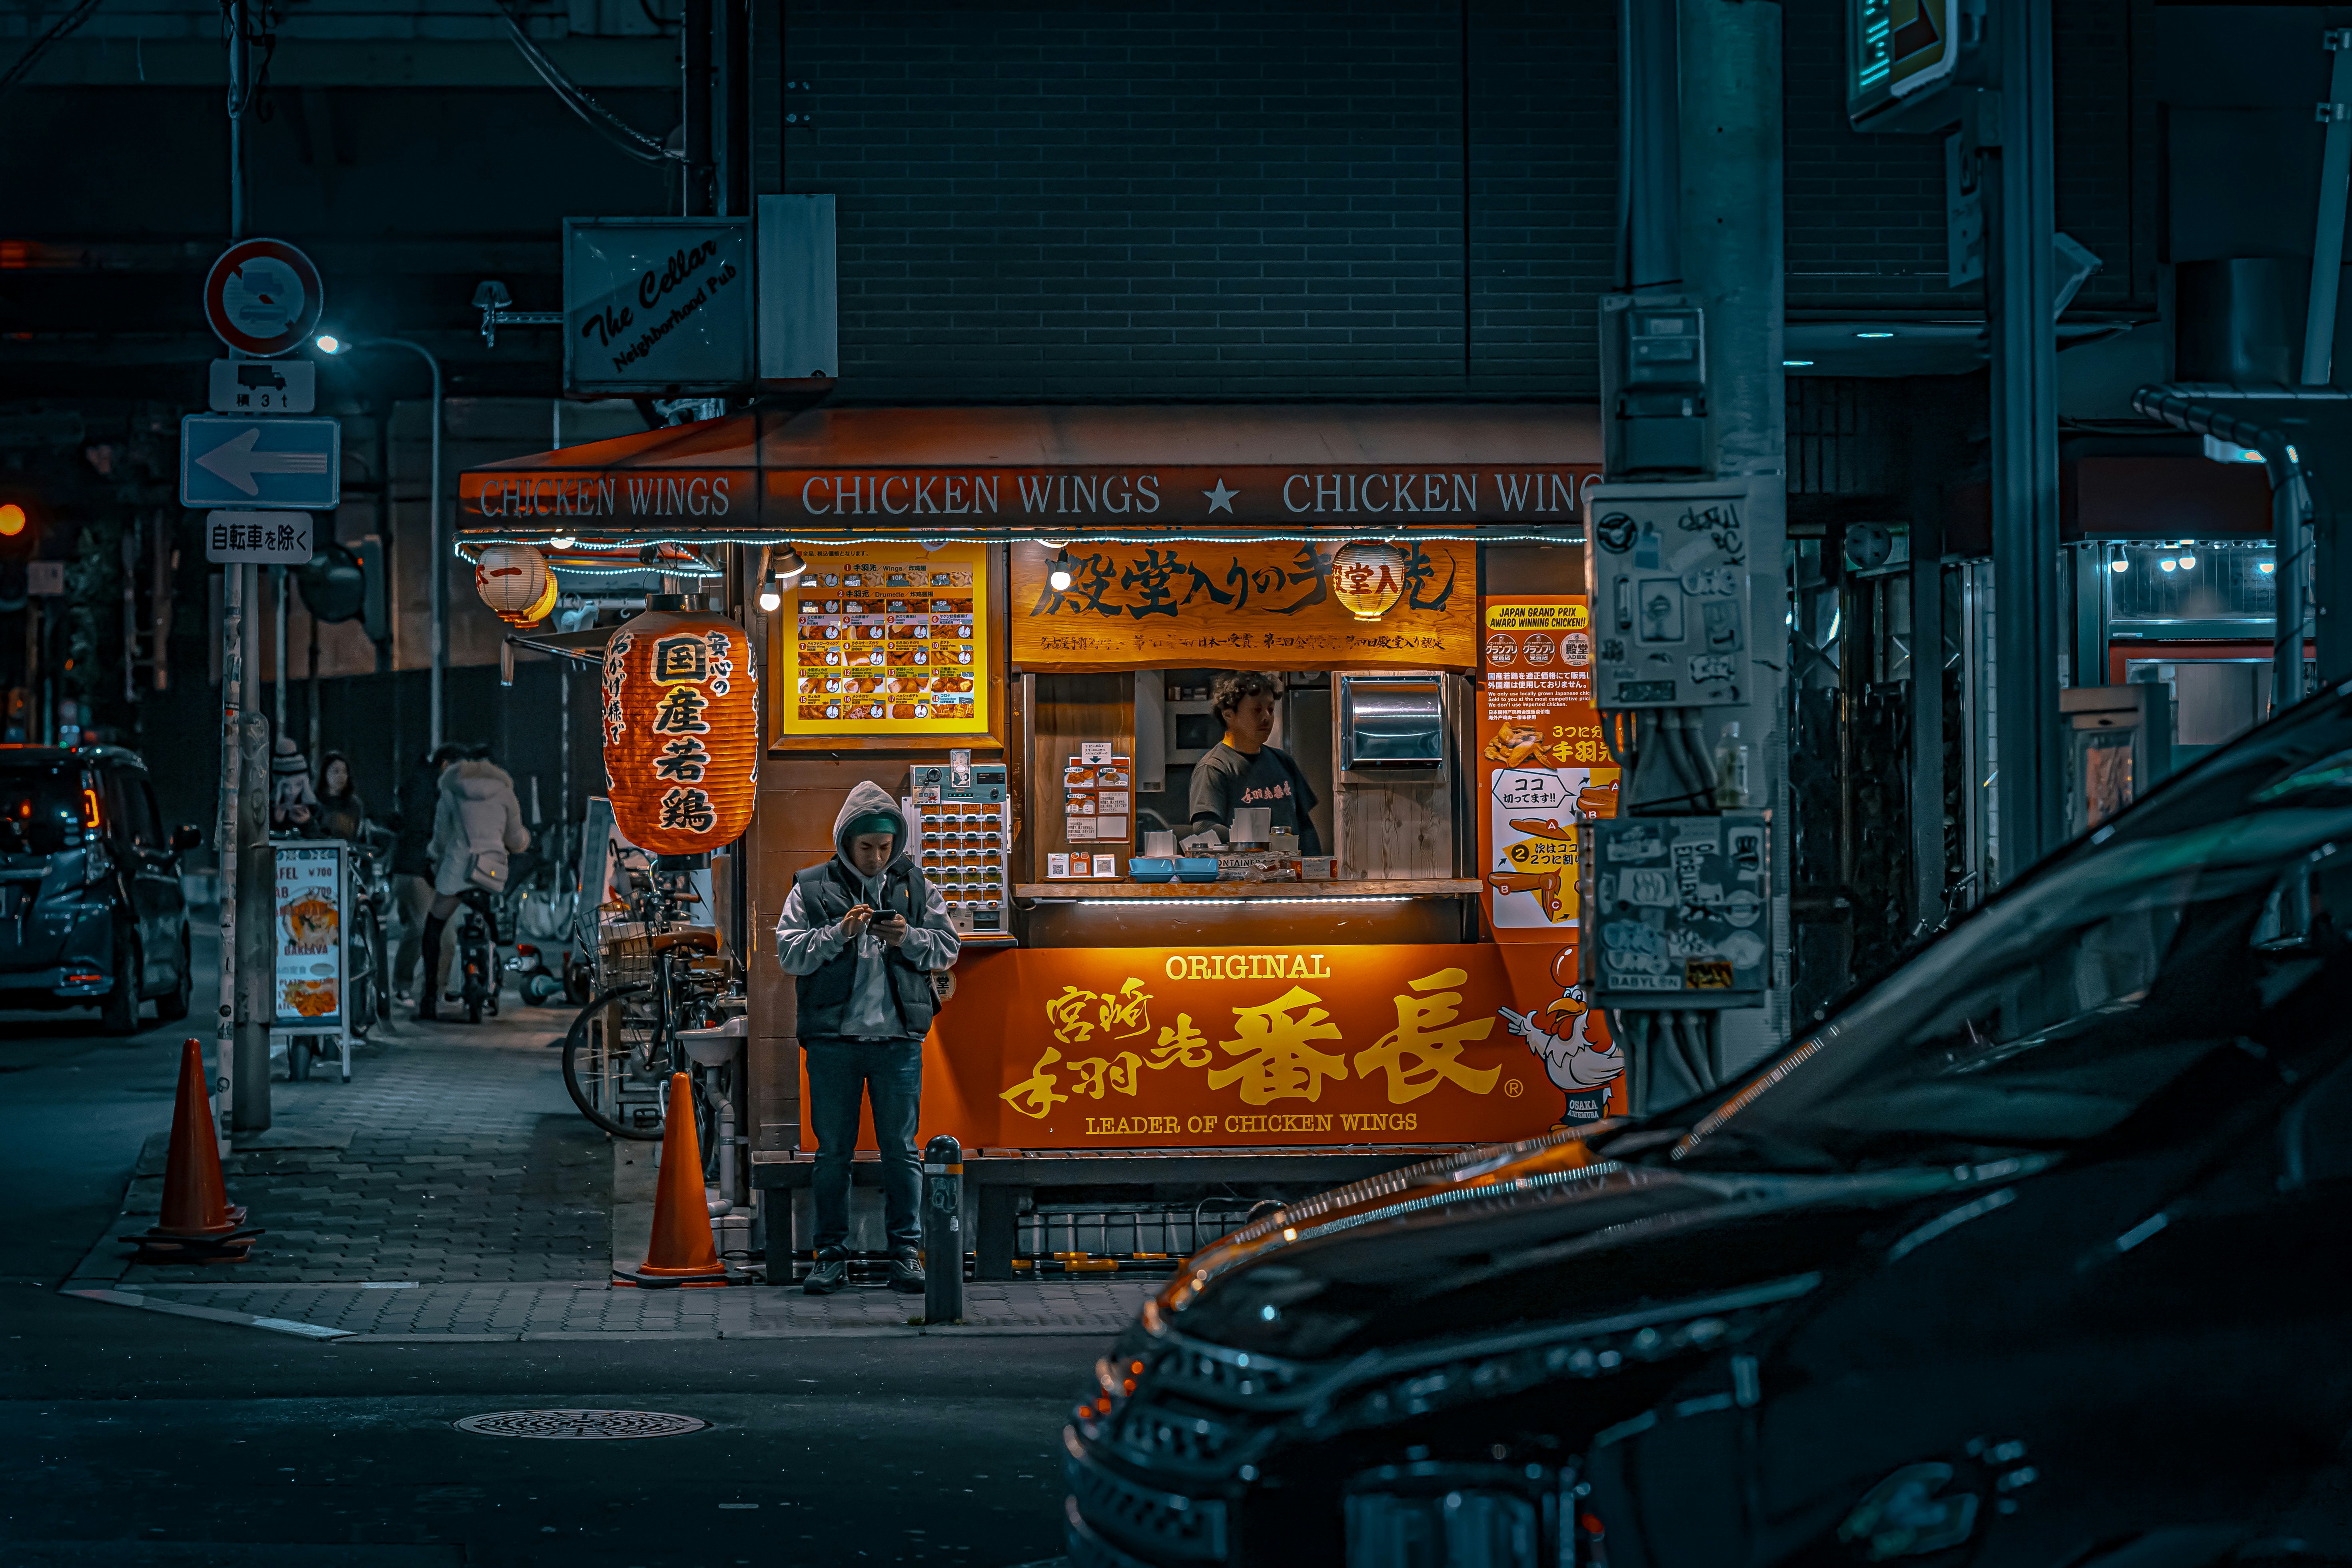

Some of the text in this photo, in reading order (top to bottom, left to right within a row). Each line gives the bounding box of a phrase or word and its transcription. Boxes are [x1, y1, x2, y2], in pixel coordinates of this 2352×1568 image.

[582, 239, 717, 347] The Cellar
[612, 264, 737, 373] Neighborhood Pub
[261, 394, 270, 407] 3
[281, 394, 288, 407] t
[481, 476, 730, 517] CHICKEN WINGS
[802, 475, 1160, 515] CHICKEN WINGS
[1283, 474, 1477, 513] CHICKEN
[212, 523, 307, 551] 自転車を除く
[1499, 607, 1577, 617] JAPAN GRAND PRIX
[1490, 617, 1586, 627] AWARD WINNING CHICKEN!!
[1485, 645, 1517, 655] グランプリ
[1523, 645, 1555, 655] グランプリ
[1566, 644, 1589, 654] 殿堂
[707, 632, 730, 694] 安心の
[609, 631, 630, 742] おかげ様で
[655, 637, 714, 829] 国産若鶏
[1515, 778, 1544, 791] ココ
[1503, 793, 1556, 804] 切ってます!!
[1547, 821, 1557, 830] A
[1515, 848, 1526, 860] 2
[1501, 885, 1509, 893] B
[1551, 901, 1560, 909] C
[1165, 955, 1331, 980] ORIGINAL
[1208, 968, 1502, 1106] 番長
[1569, 1100, 1598, 1110] OSAKA
[1567, 1109, 1599, 1119] AMEMURA
[1086, 1113, 1418, 1135] LEADER OF CHICKEN WINGS
